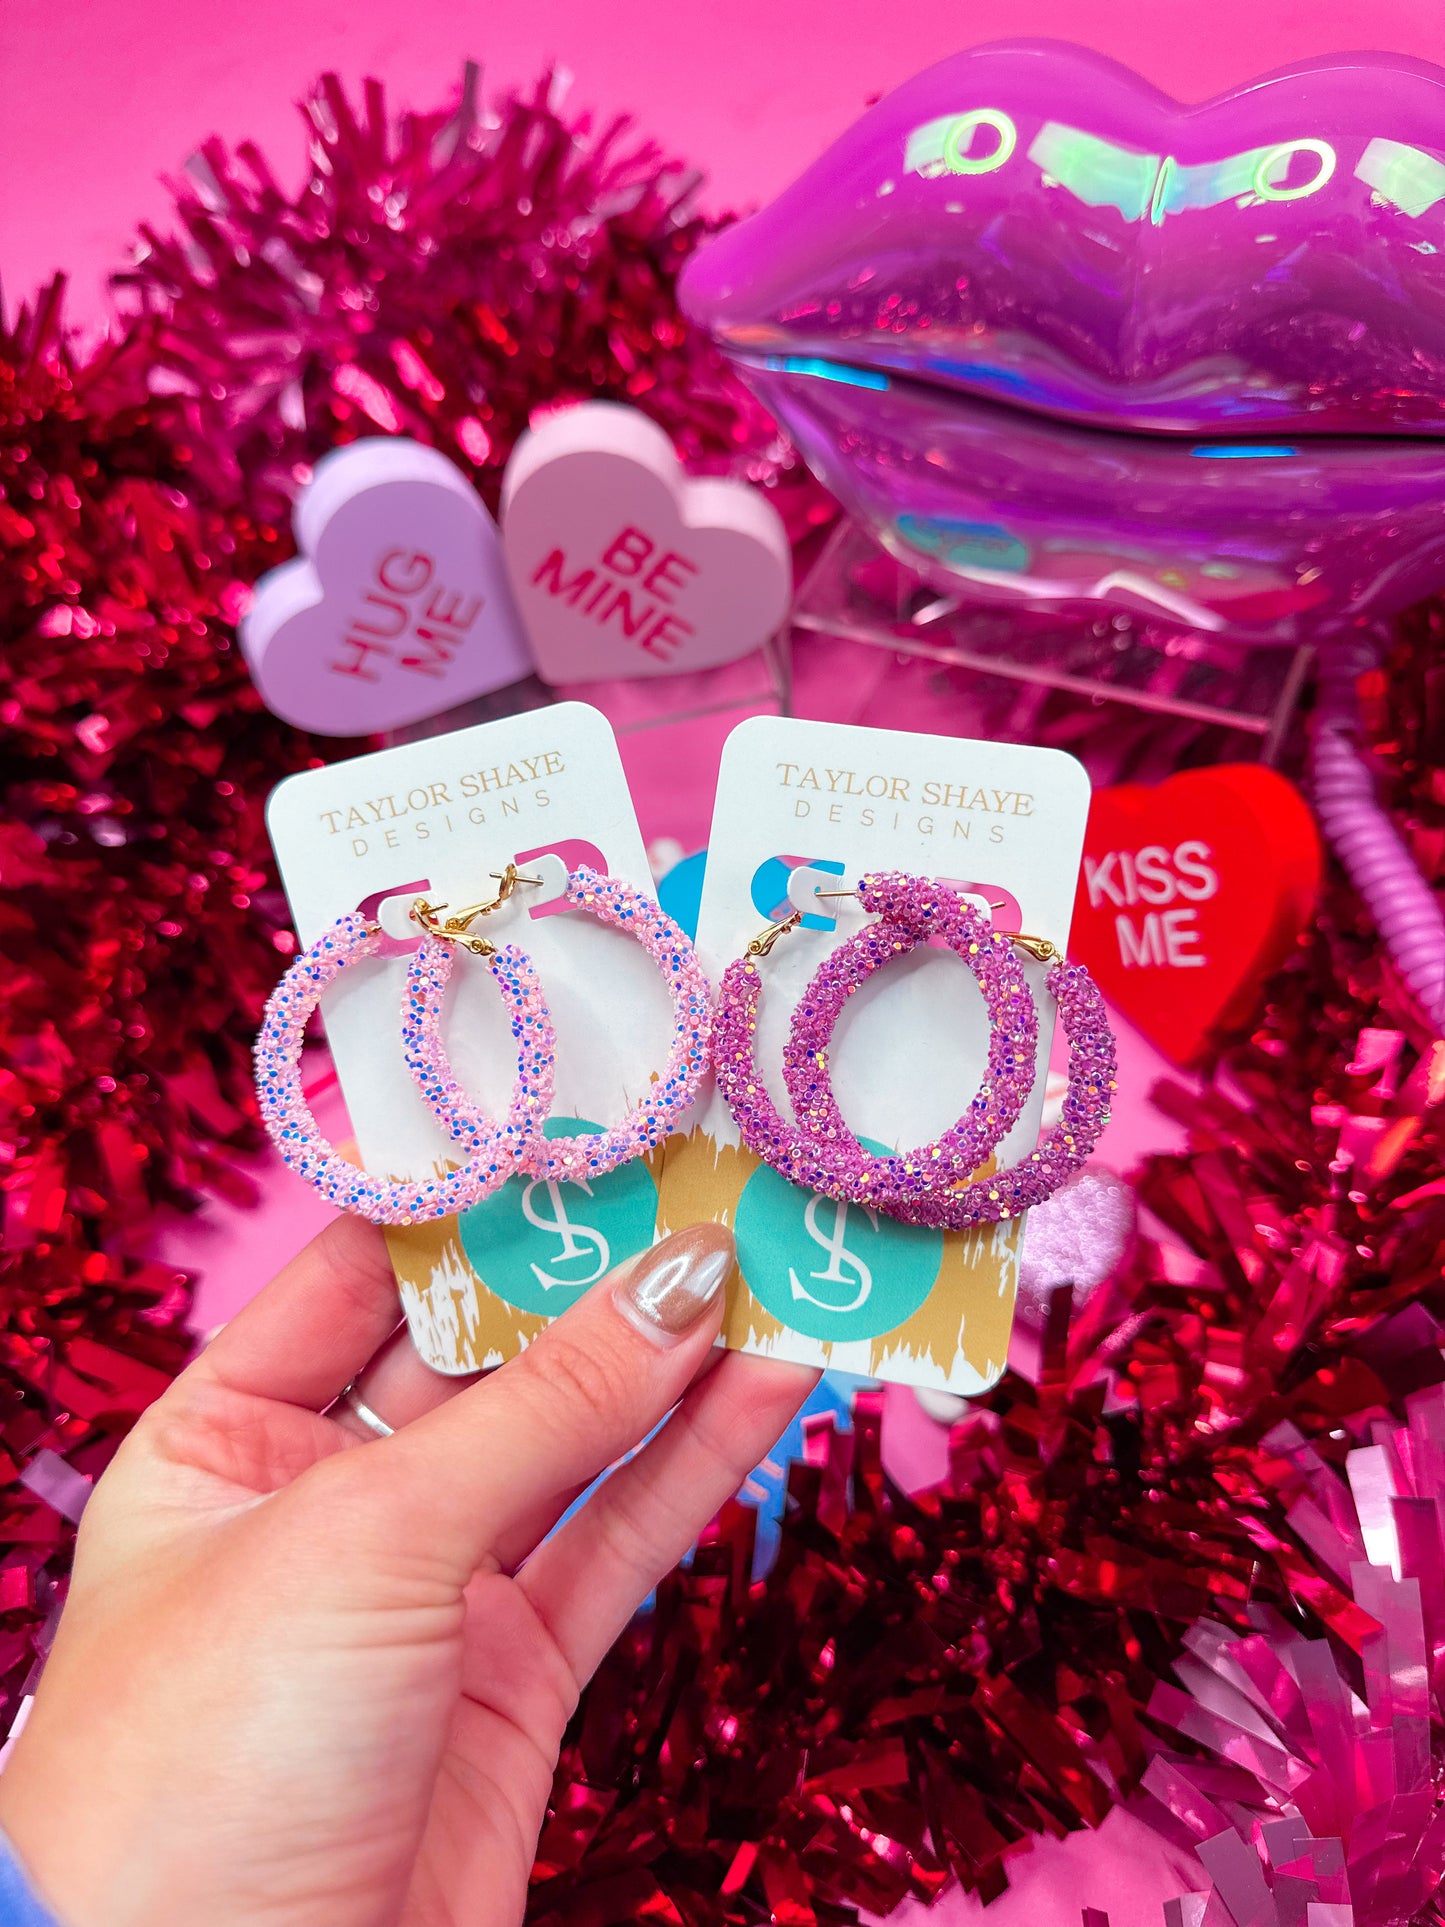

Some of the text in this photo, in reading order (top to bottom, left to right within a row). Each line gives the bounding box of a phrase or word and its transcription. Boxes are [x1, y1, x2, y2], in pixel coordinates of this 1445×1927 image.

[602, 526, 701, 603] BE
[328, 546, 436, 682] HUG
[400, 586, 487, 678] ME
[531, 548, 696, 663] MINE
[319, 750, 566, 835] TAYLOR SHAYE
[351, 789, 552, 857] DESIGNS
[775, 762, 1035, 817] TAYLOR SHAYE
[794, 799, 1005, 844] DESIGNS
[1084, 840, 1219, 908] KISS
[1115, 907, 1208, 969] ME
